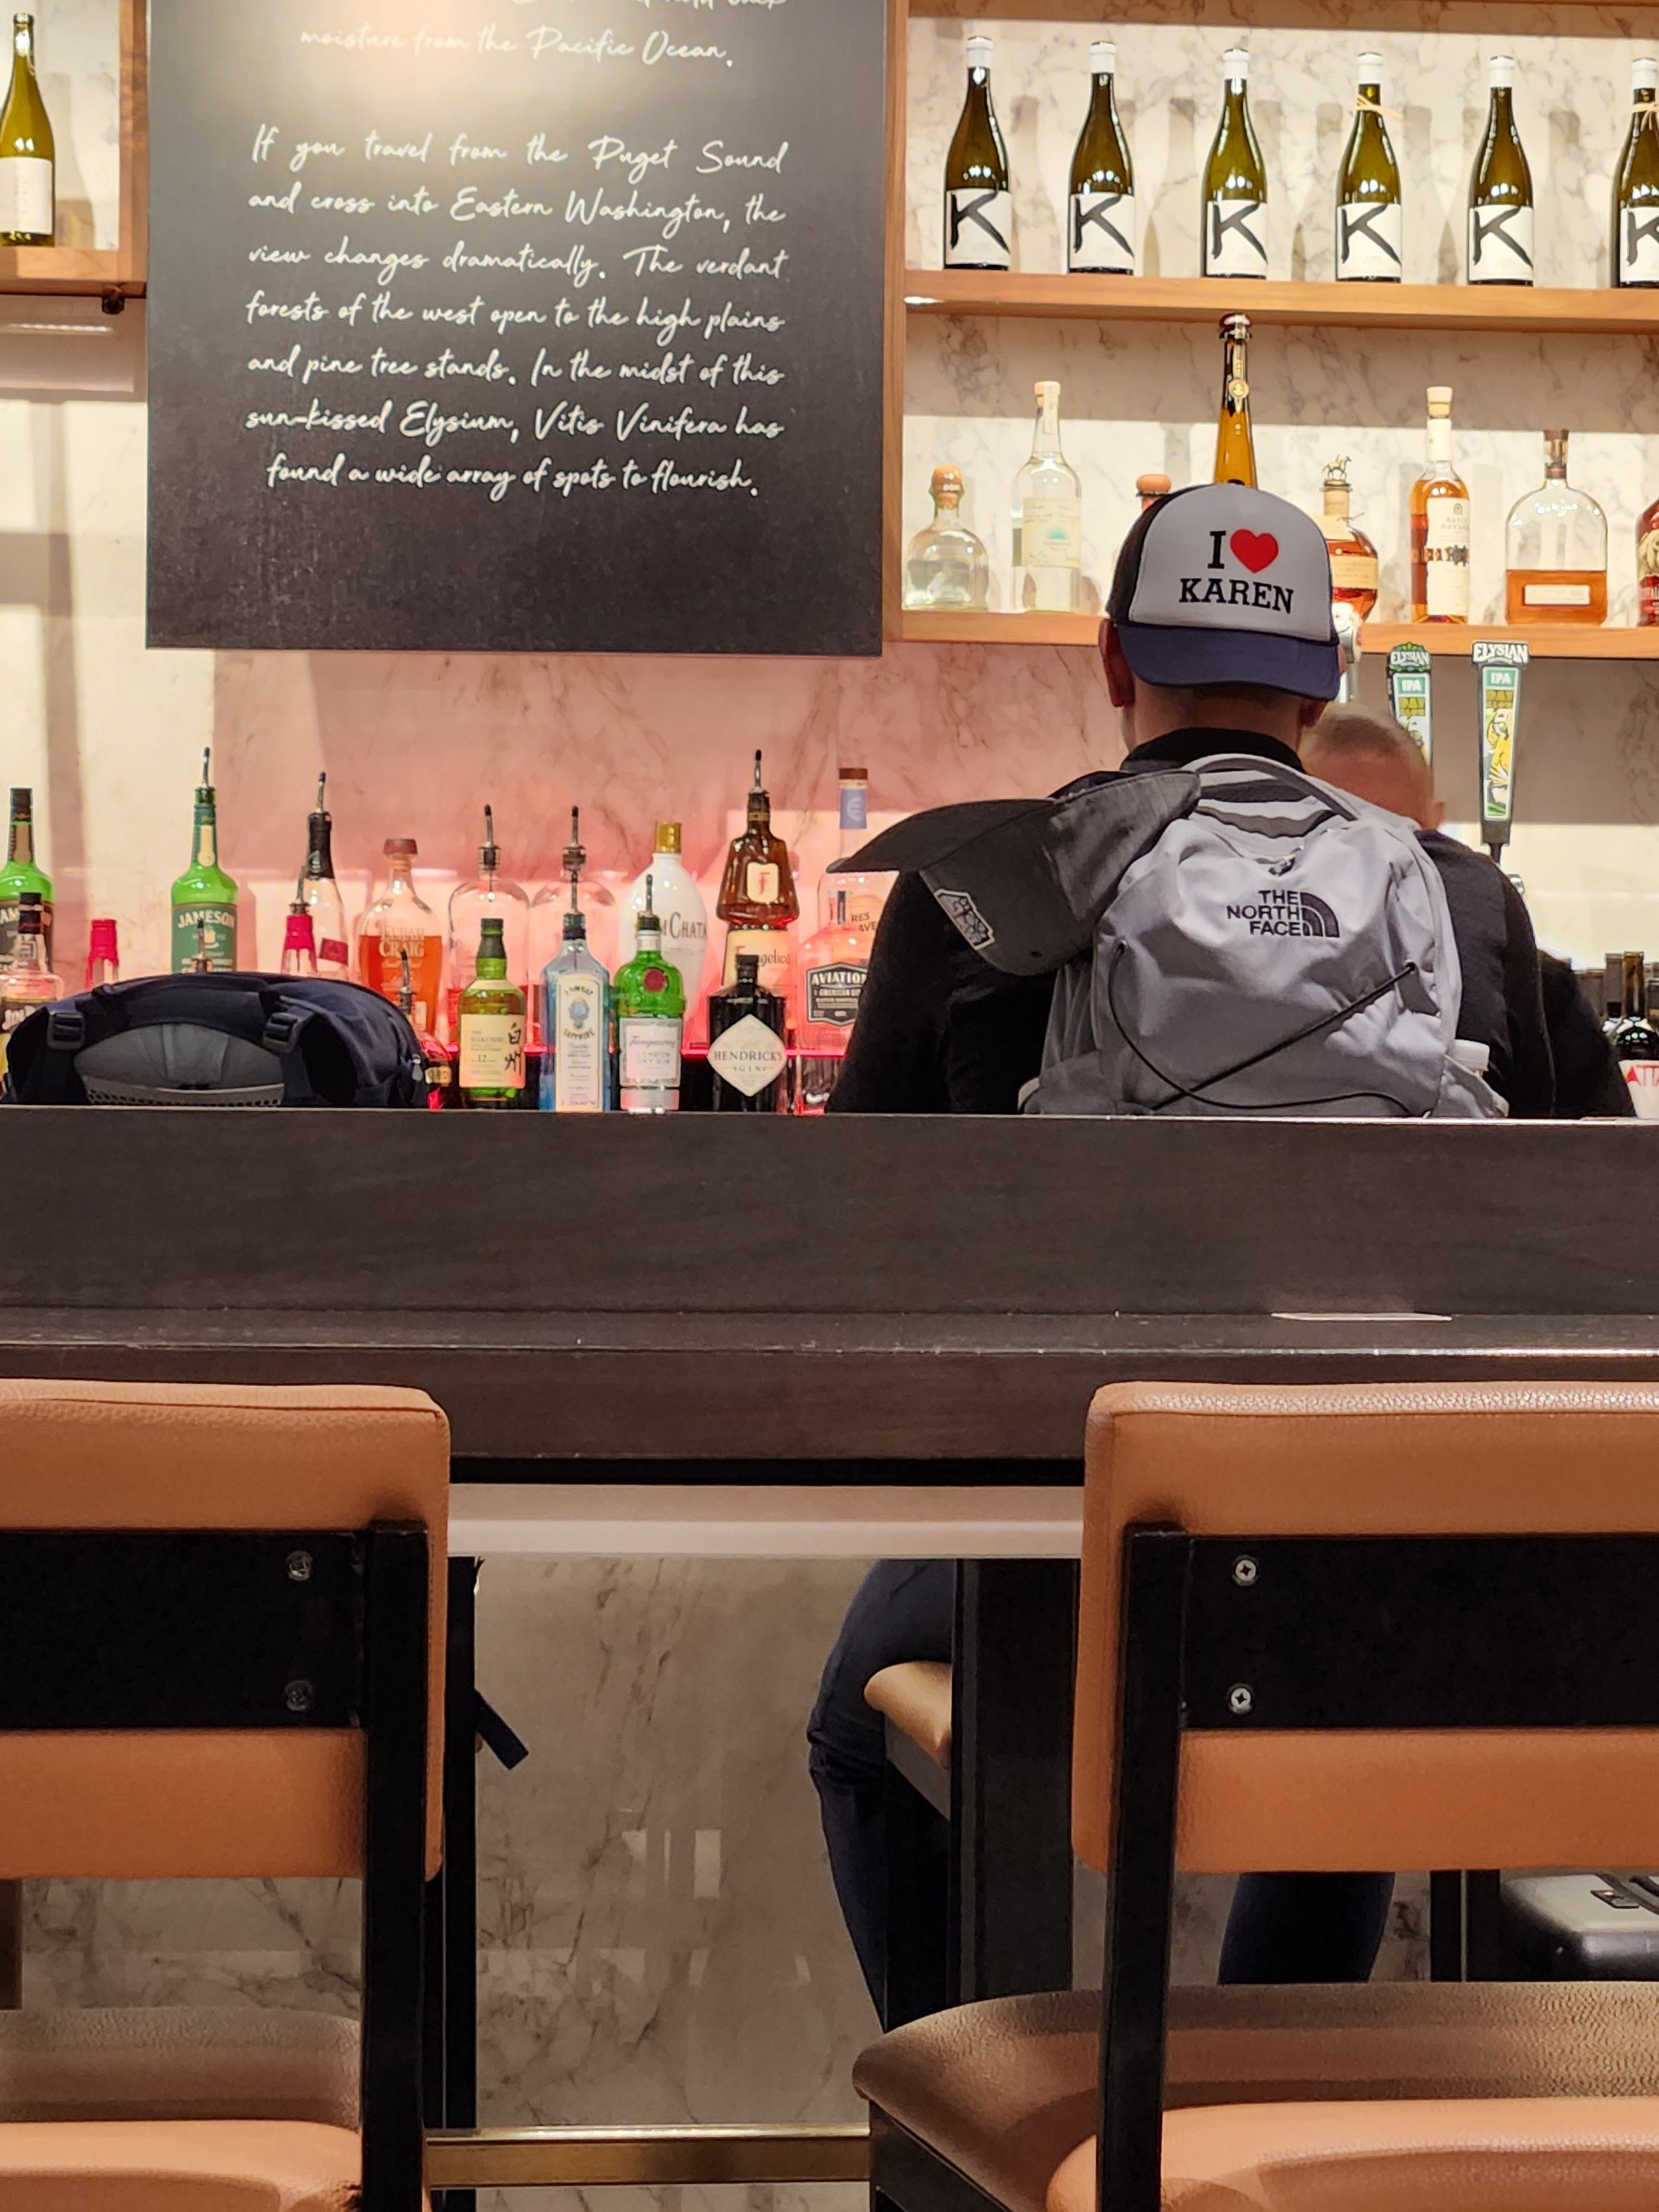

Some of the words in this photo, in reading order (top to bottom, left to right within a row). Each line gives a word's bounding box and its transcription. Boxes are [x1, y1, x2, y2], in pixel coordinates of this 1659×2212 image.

[300, 21, 407, 48] moisture
[413, 23, 469, 54] from
[477, 22, 518, 53] the
[526, 25, 635, 62] Pacific
[642, 30, 733, 67] Ocean.
[252, 123, 279, 163] If
[289, 143, 346, 172] you
[364, 130, 433, 162] travel
[449, 133, 508, 167] from
[527, 133, 568, 165] the
[588, 135, 678, 184] Puget
[695, 141, 789, 174] Sound
[248, 181, 303, 214] and
[311, 196, 376, 214] cross
[388, 186, 439, 216] into
[450, 186, 553, 221] Eastern
[565, 187, 731, 240] Washington,
[745, 193, 787, 224] the
[950, 190, 1011, 256] K
[1072, 194, 1135, 261] K
[1211, 201, 1269, 265] K
[1341, 203, 1402, 265] K
[1472, 206, 1534, 269] K
[248, 245, 311, 263] view
[324, 236, 429, 285] changes
[443, 240, 607, 288] dramatically.
[622, 244, 684, 277] The
[695, 248, 790, 279] verdant
[246, 289, 329, 325] forests
[338, 293, 366, 327] of
[372, 291, 414, 323] the
[422, 295, 485, 325] west
[490, 311, 547, 334] open
[554, 297, 581, 328] to
[587, 296, 629, 329] the
[636, 296, 701, 347] high
[703, 301, 786, 340] plains
[248, 344, 301, 378] and
[301, 355, 364, 384] pine
[370, 346, 419, 378] tree
[423, 348, 517, 386] stands.
[530, 347, 563, 388] In
[569, 348, 612, 382] the
[619, 352, 695, 385] midst
[699, 354, 729, 388] of
[732, 352, 786, 385] this
[245, 398, 394, 434] sun-kissed
[399, 400, 520, 447] Elysium,
[534, 401, 605, 440] Vitis
[616, 402, 728, 442] Vinifera
[735, 406, 785, 438] has
[265, 452, 346, 488] found
[348, 467, 370, 482] a
[374, 455, 442, 488] wide
[446, 469, 517, 502] array
[522, 457, 553, 492] of
[552, 458, 617, 497] spots
[621, 459, 648, 489] to
[650, 459, 758, 497] flourish.
[1207, 530, 1226, 569] I
[1178, 577, 1295, 615] KAREN
[1390, 650, 1431, 666] ELYSIAN
[1472, 641, 1529, 664] ELYSIAN
[1401, 679, 1422, 692] IPA
[1490, 672, 1511, 686] IPA
[1226, 905, 1300, 921] NORTH
[1258, 889, 1299, 905] THE
[177, 910, 236, 929] JAMESON
[1249, 921, 1301, 936] FACE
[378, 940, 425, 958] CRAIG
[478, 1054, 487, 1063] 12
